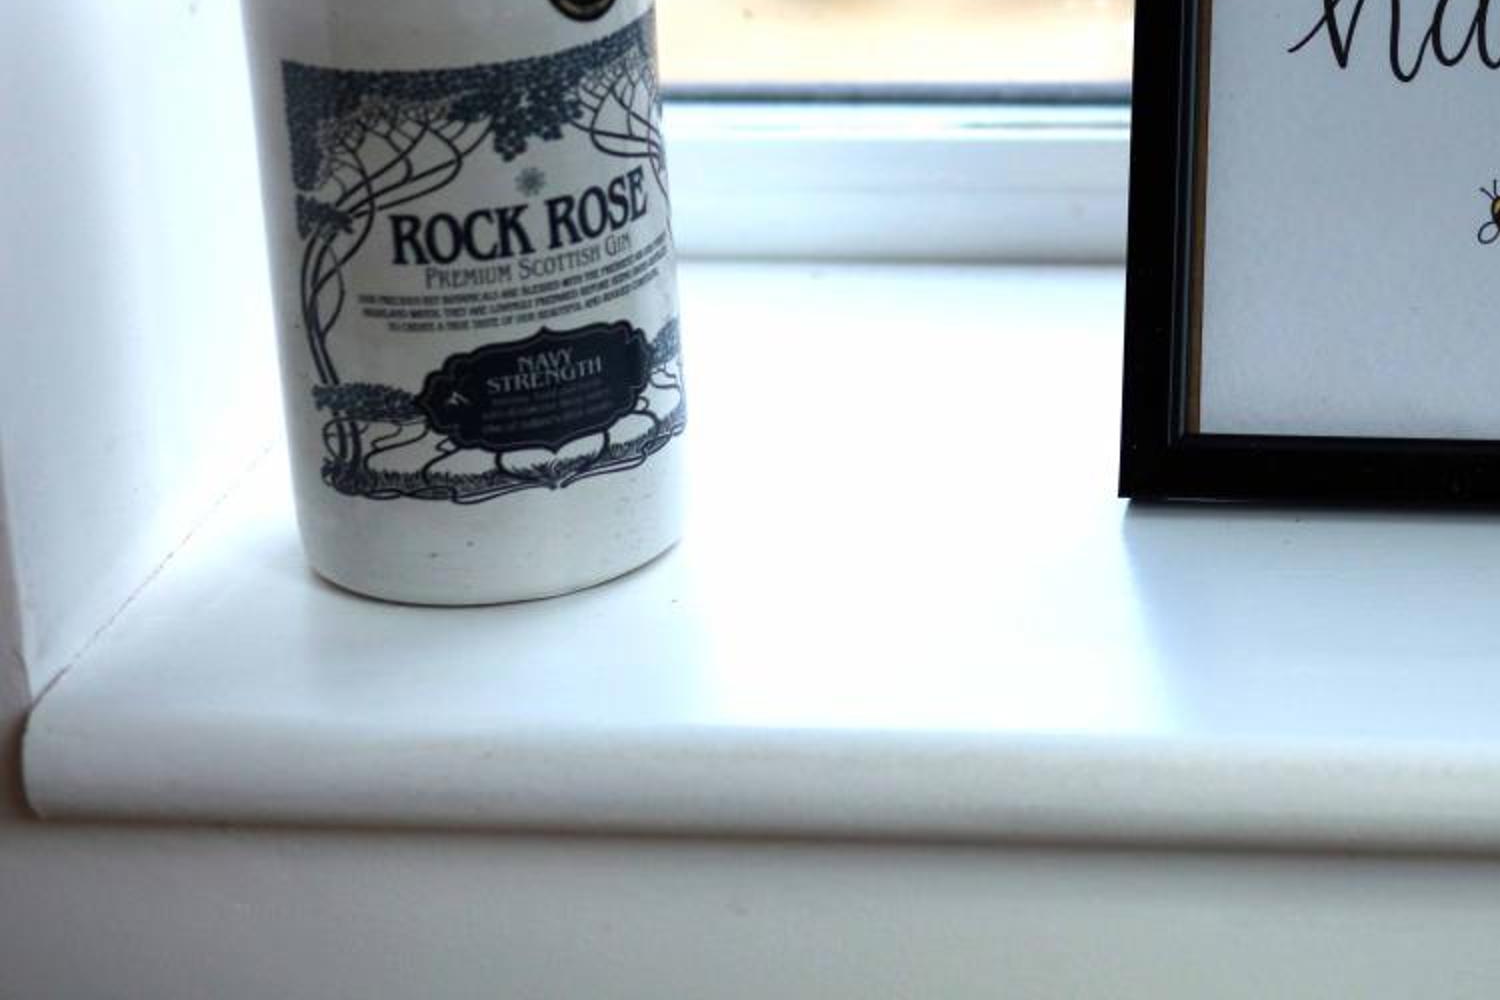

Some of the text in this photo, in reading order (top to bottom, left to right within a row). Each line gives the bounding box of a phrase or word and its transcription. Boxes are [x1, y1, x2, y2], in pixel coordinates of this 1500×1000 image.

[390, 204, 535, 266] ROCK
[545, 165, 649, 250] ROSE
[425, 264, 512, 290] PREMIUM
[518, 245, 600, 279] SCOTTISH
[485, 355, 602, 393] STRENGTH
[516, 345, 574, 372] NAVY
